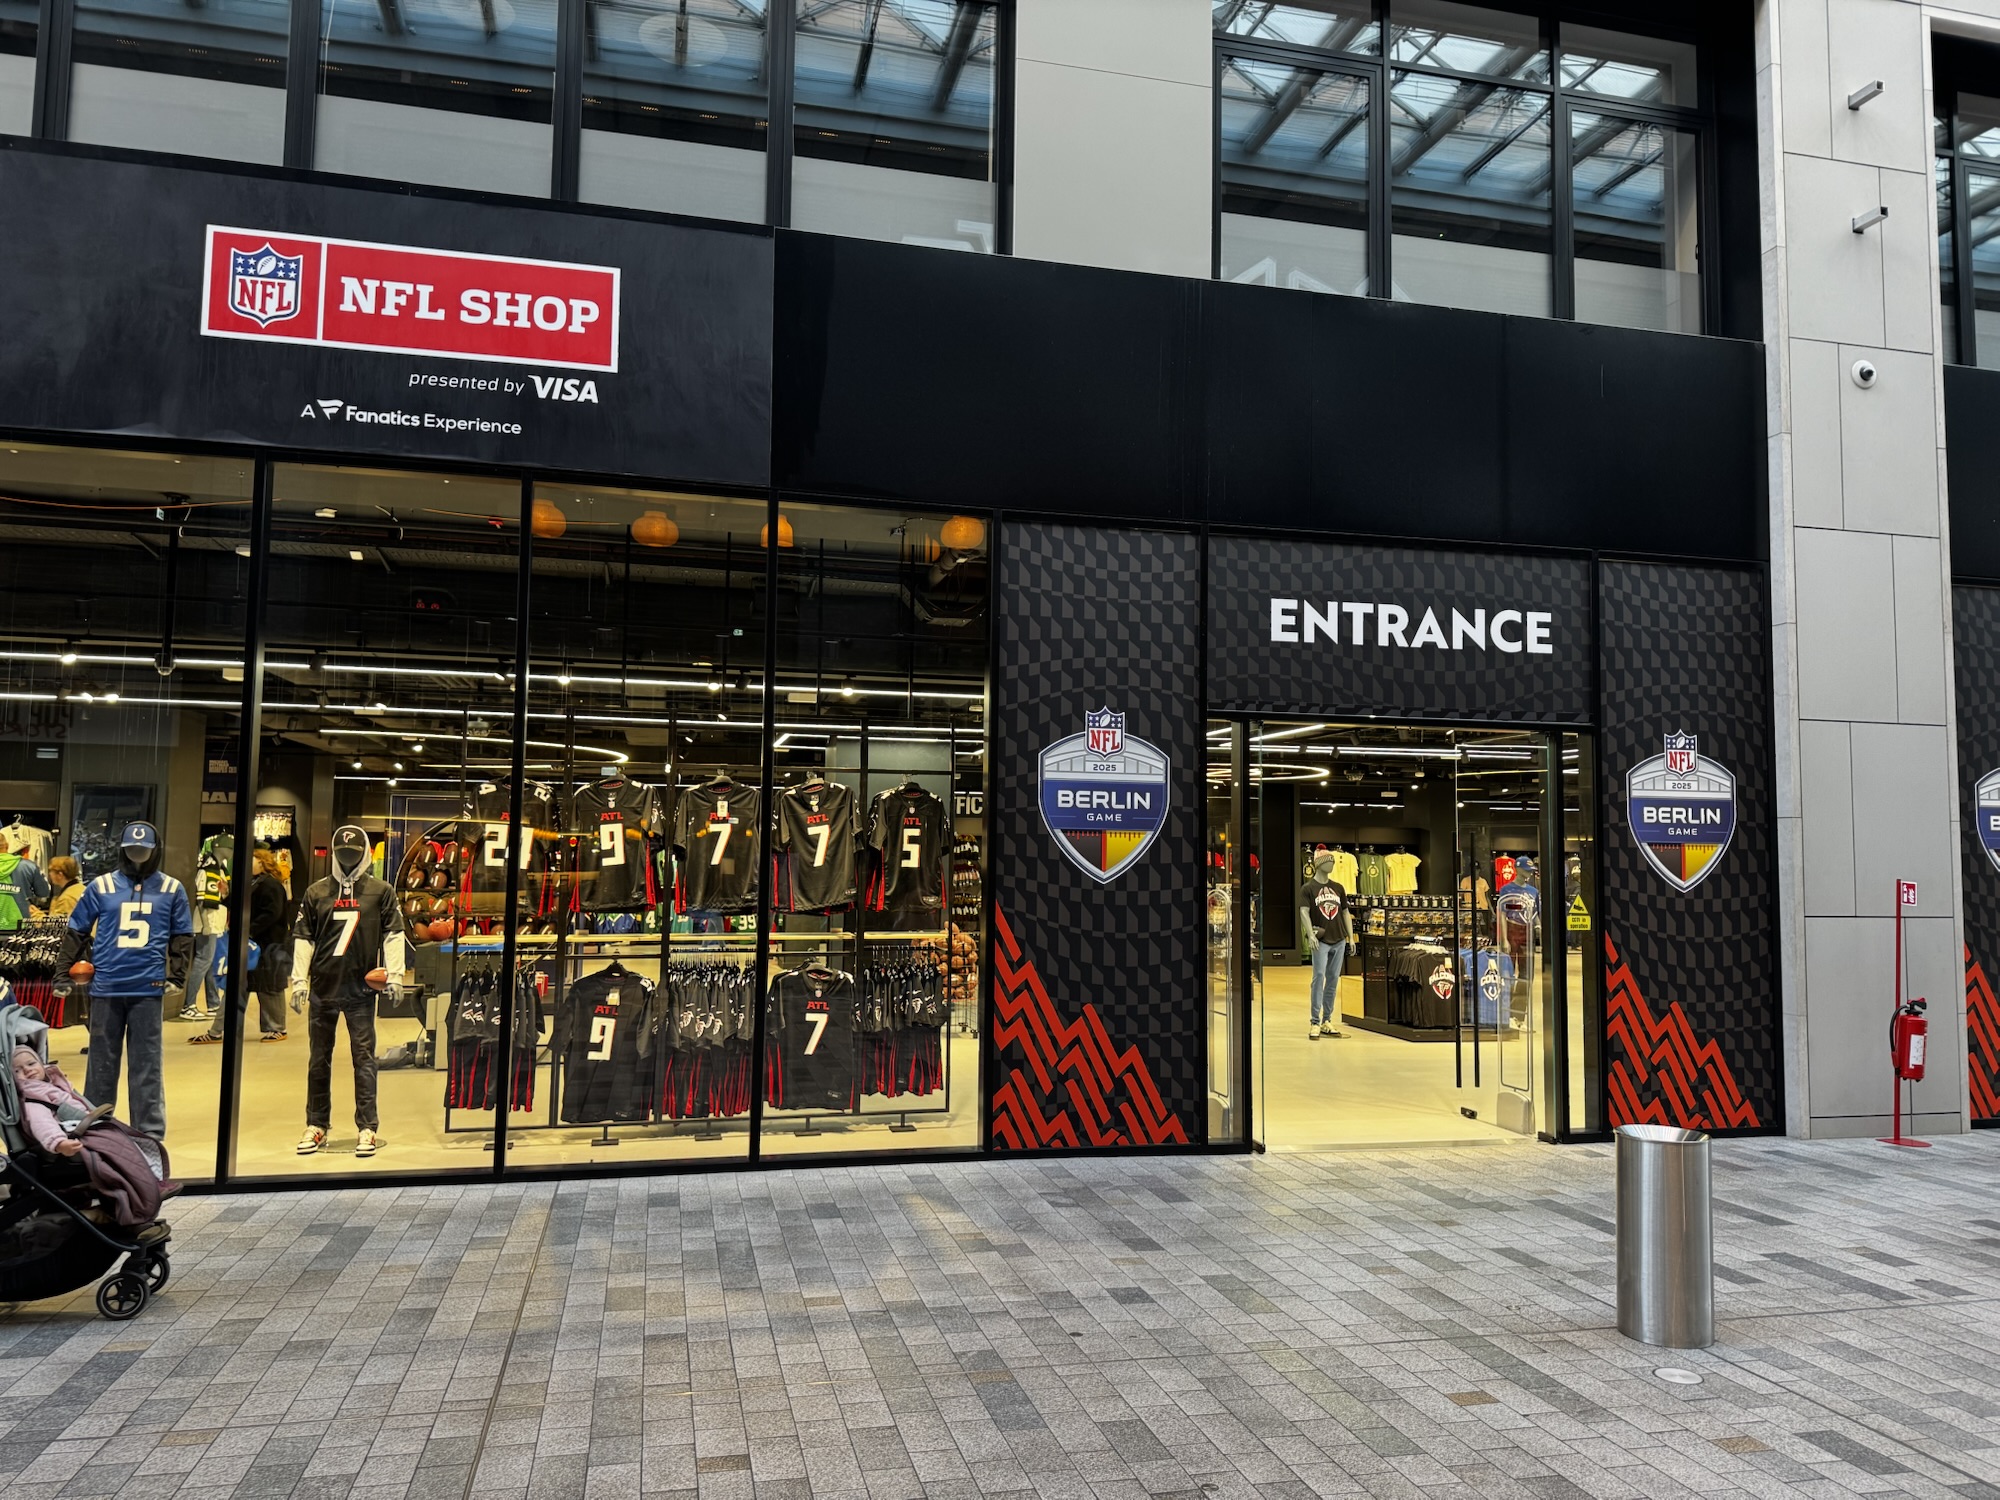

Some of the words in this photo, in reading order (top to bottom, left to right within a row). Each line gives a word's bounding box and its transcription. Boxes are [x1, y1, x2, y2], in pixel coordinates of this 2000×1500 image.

[237, 278, 292, 315] NFL
[339, 275, 445, 321] NFL
[460, 288, 600, 334] SHOP
[408, 372, 499, 392] presented
[504, 377, 525, 396] by
[527, 374, 599, 404] VISA
[300, 405, 316, 419] A
[346, 405, 421, 428] Fanatics
[424, 413, 522, 435] Experience
[1270, 597, 1553, 654] ENTRANCE
[1090, 729, 1120, 752] NFL
[1092, 763, 1117, 772] 2025
[1668, 751, 1694, 772] NFL
[1671, 782, 1692, 790] 2025
[1057, 789, 1151, 810] BERLIN
[600, 811, 624, 821] ATL
[806, 813, 829, 825] ATL
[903, 817, 922, 826] ATL
[1086, 813, 1123, 822] GAME
[1643, 806, 1721, 825] BERLIN
[1668, 827, 1698, 836] GAME
[600, 823, 626, 867] 9
[709, 823, 732, 866] 7
[807, 824, 831, 867] 7
[901, 828, 922, 868] 5
[333, 898, 361, 908] ATL
[117, 901, 153, 949] 5
[332, 910, 361, 957] 7
[594, 1005, 619, 1015] ATL
[806, 1001, 830, 1010] ATL
[587, 1016, 617, 1061] 9
[804, 1012, 829, 1056] 7
